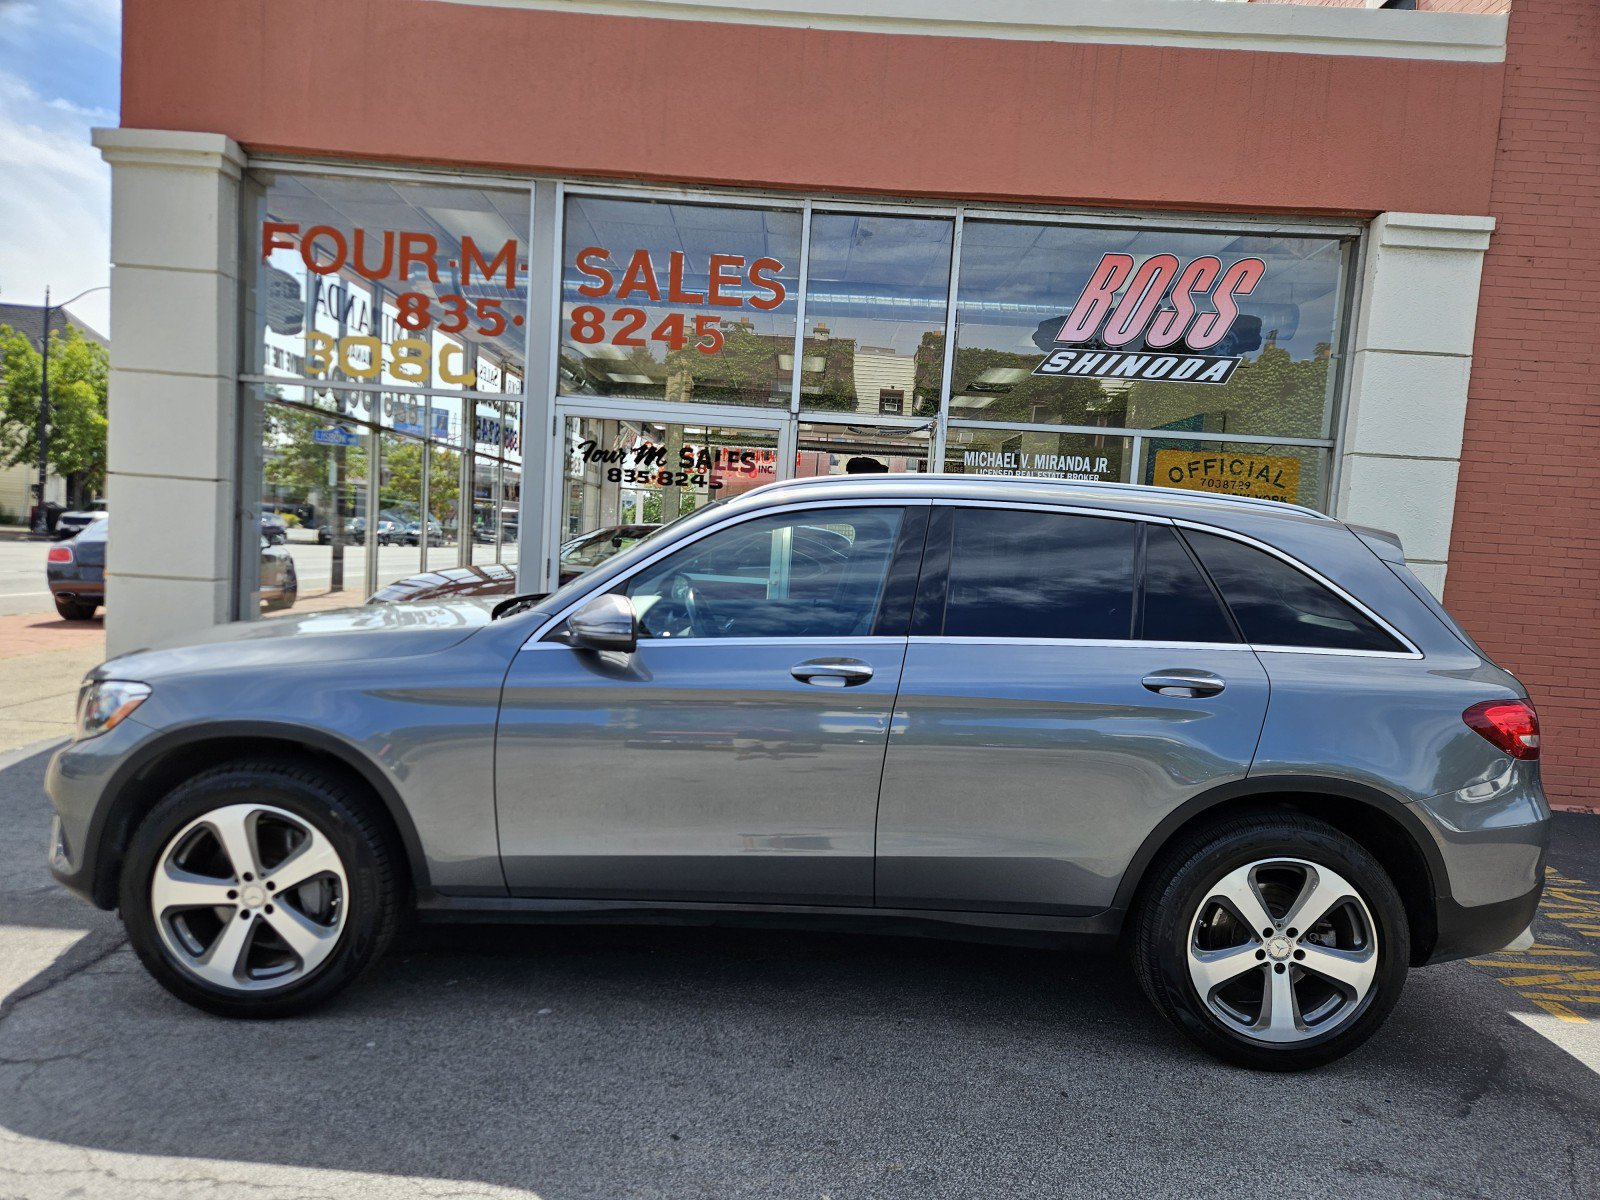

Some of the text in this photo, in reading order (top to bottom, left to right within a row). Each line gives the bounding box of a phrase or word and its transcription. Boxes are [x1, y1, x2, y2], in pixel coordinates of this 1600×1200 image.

[261, 221, 440, 283] FOUR
[575, 246, 786, 310] SALES
[1055, 252, 1266, 350] BOSS
[569, 305, 724, 355] 8245
[1041, 350, 1233, 382] SHINODA
[679, 446, 757, 473] SALES
[758, 464, 776, 475] INC.
[964, 451, 1018, 469] MICHAEL
[1020, 454, 1031, 469] V.
[1034, 454, 1091, 472] MIRANDA
[1093, 457, 1111, 473] JR.
[975, 468, 1100, 482] LICENSED REAL ESTATE BROKER
[1168, 458, 1286, 489] OFFICIAL
[1200, 478, 1251, 490] 7038729
